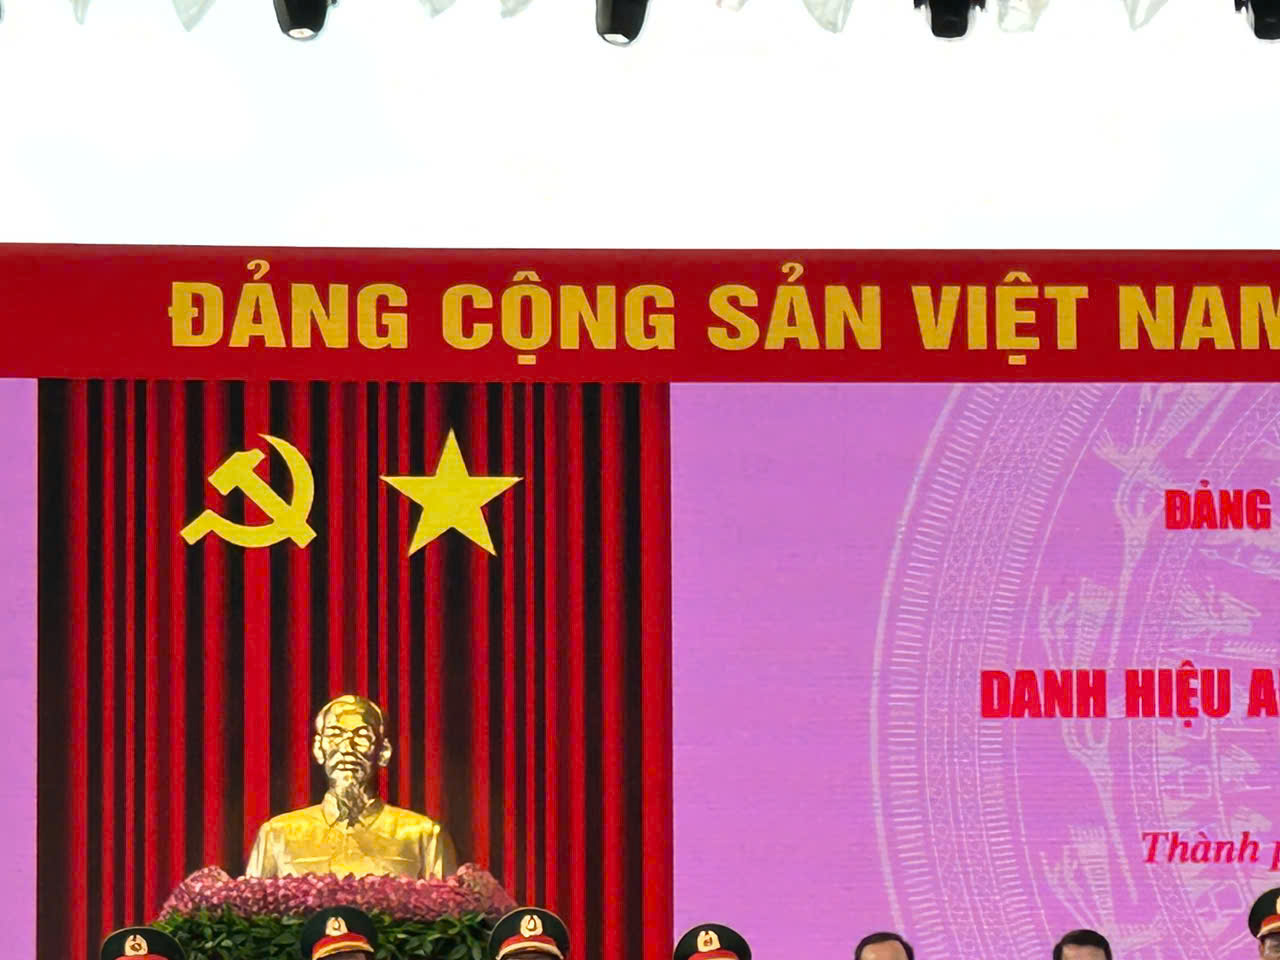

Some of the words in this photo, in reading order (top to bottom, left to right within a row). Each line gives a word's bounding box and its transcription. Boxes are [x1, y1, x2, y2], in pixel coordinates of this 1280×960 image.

[168, 260, 408, 350] ĐẢNG
[443, 271, 675, 365] CỘNG
[708, 263, 881, 351] SẢN
[912, 272, 1089, 365] VIỆT
[1164, 480, 1272, 530] ĐẢNG
[980, 669, 1107, 719] DANH
[1125, 660, 1231, 728] HIỆU
[1142, 831, 1259, 864] Thành
